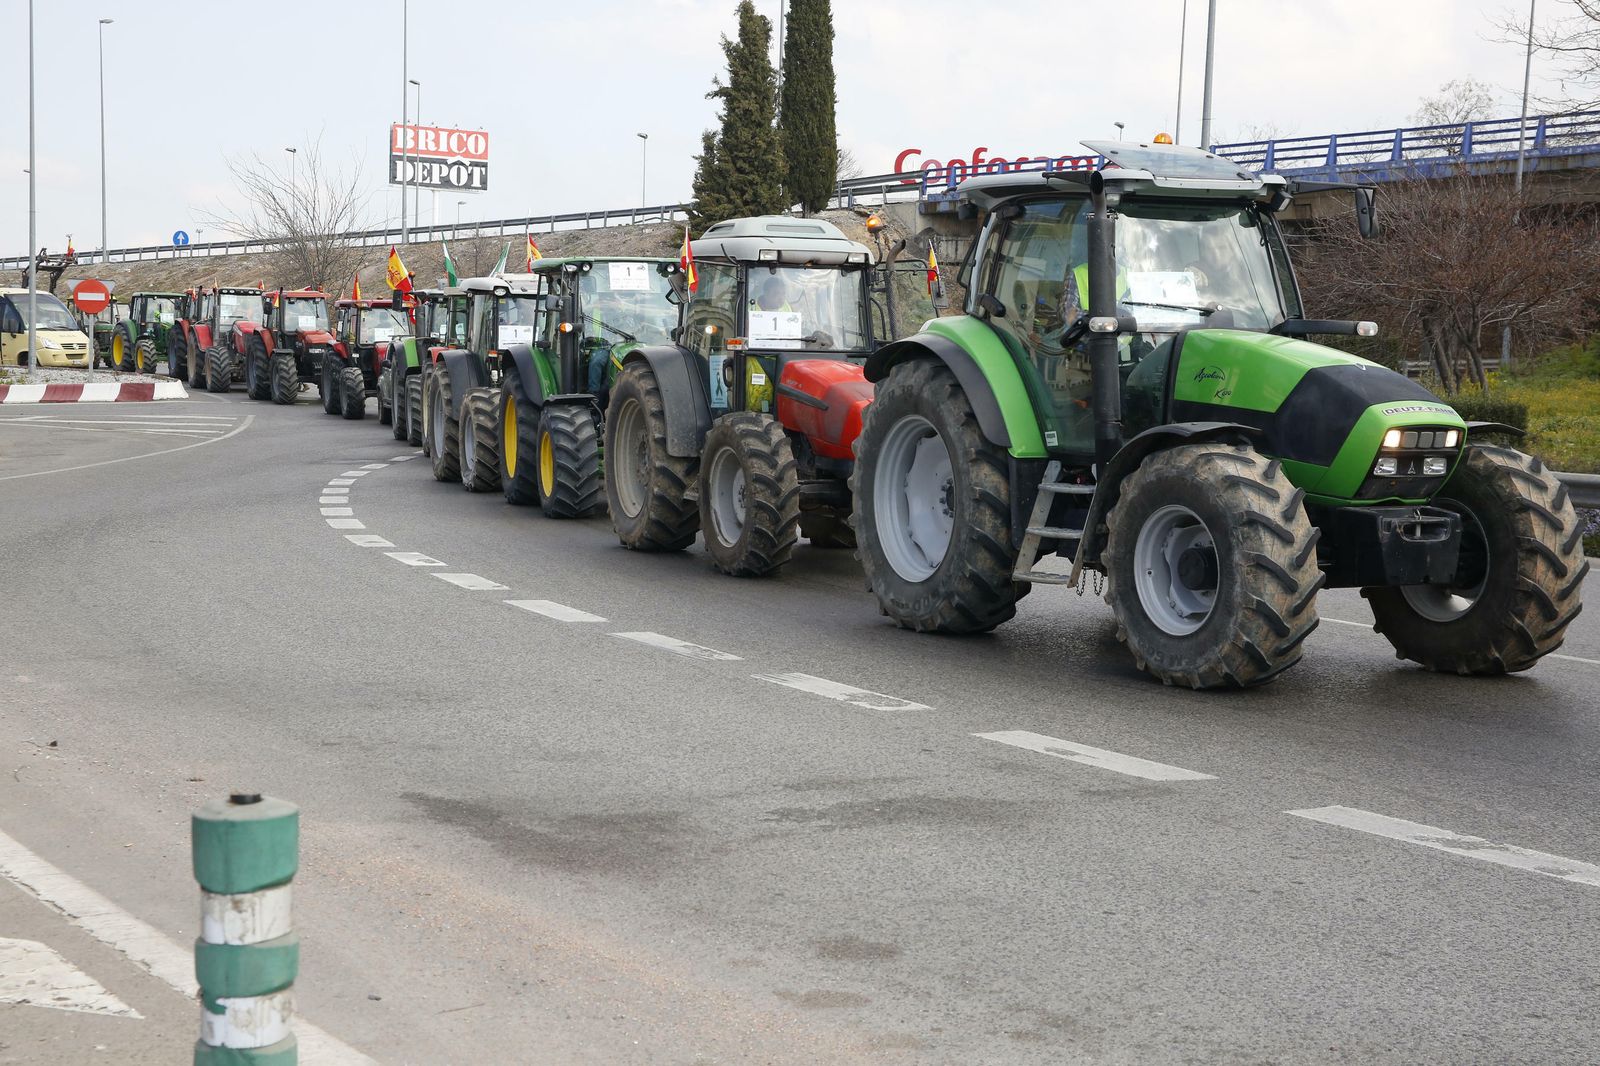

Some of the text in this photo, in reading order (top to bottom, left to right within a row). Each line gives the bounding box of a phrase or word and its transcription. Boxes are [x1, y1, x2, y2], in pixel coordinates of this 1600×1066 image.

[395, 127, 486, 155] BRICO
[894, 147, 1119, 183] Conforam
[772, 316, 778, 331] 1
